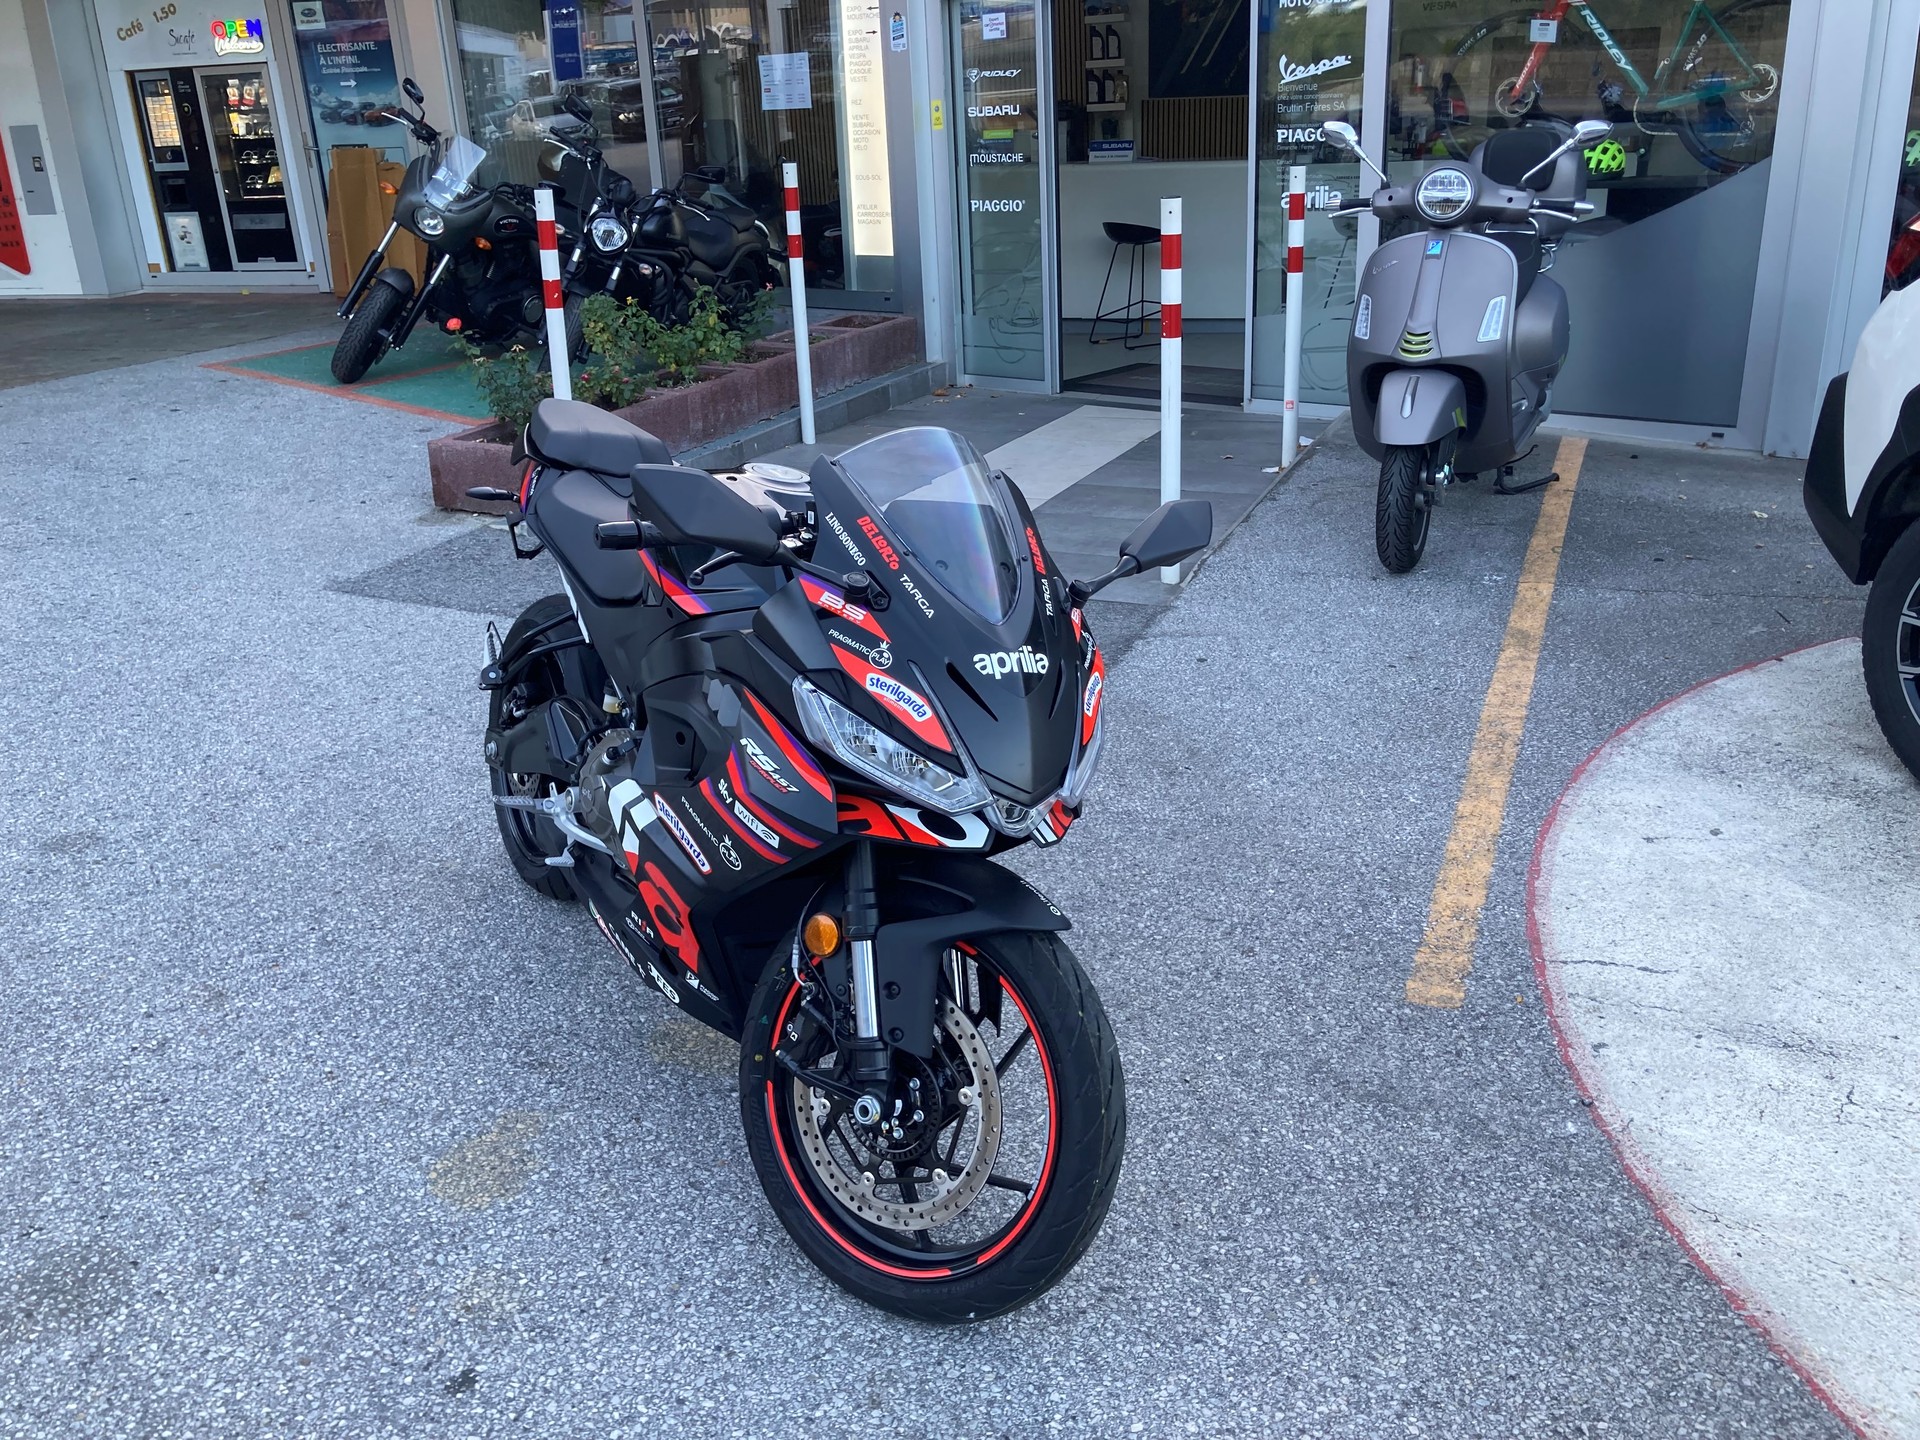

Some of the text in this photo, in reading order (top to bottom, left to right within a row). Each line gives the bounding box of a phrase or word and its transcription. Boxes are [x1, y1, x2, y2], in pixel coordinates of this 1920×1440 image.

[846, 12, 880, 20] MOUSTACHE
[1422, 1, 1458, 11] VESPA
[116, 3, 177, 42] Café 1.50
[210, 18, 263, 39] OPEN
[215, 34, 264, 55] Welcome
[317, 41, 378, 53] ÉLECTRISANTE.
[1580, 9, 1633, 71] RIDLEY
[319, 55, 361, 65] À L'INFINI.
[849, 67, 872, 75] CASQUE
[1279, 54, 1352, 84] Vespa
[1515, 48, 1536, 89] RIDLEY
[980, 68, 1022, 78] RIDLEY
[1277, 83, 1318, 92] Bienvenue
[967, 104, 1021, 117] SUBARU
[1277, 101, 1345, 113] Bruttin Frères SA
[1276, 128, 1326, 143] PIAGG
[969, 153, 1024, 166] MOUSTACHE
[970, 199, 1023, 212] PIAGGIO
[1281, 185, 1342, 209] arilia
[825, 511, 866, 566] LINO SONEGO
[819, 591, 867, 620] BS
[900, 573, 935, 619] TARGA
[1041, 578, 1054, 616] TARGA
[828, 628, 872, 655] PRAGMATIC
[871, 651, 890, 666] PLAY
[972, 645, 1049, 680] aprilia
[869, 676, 927, 719] sterilgarda
[740, 737, 780, 772] RS
[718, 778, 733, 804] sky
[768, 771, 800, 792] 457
[681, 796, 719, 847] PRAGMATIC
[737, 806, 759, 831] wifi
[657, 799, 706, 868] sterilgarda
[721, 846, 740, 867] PLAY
